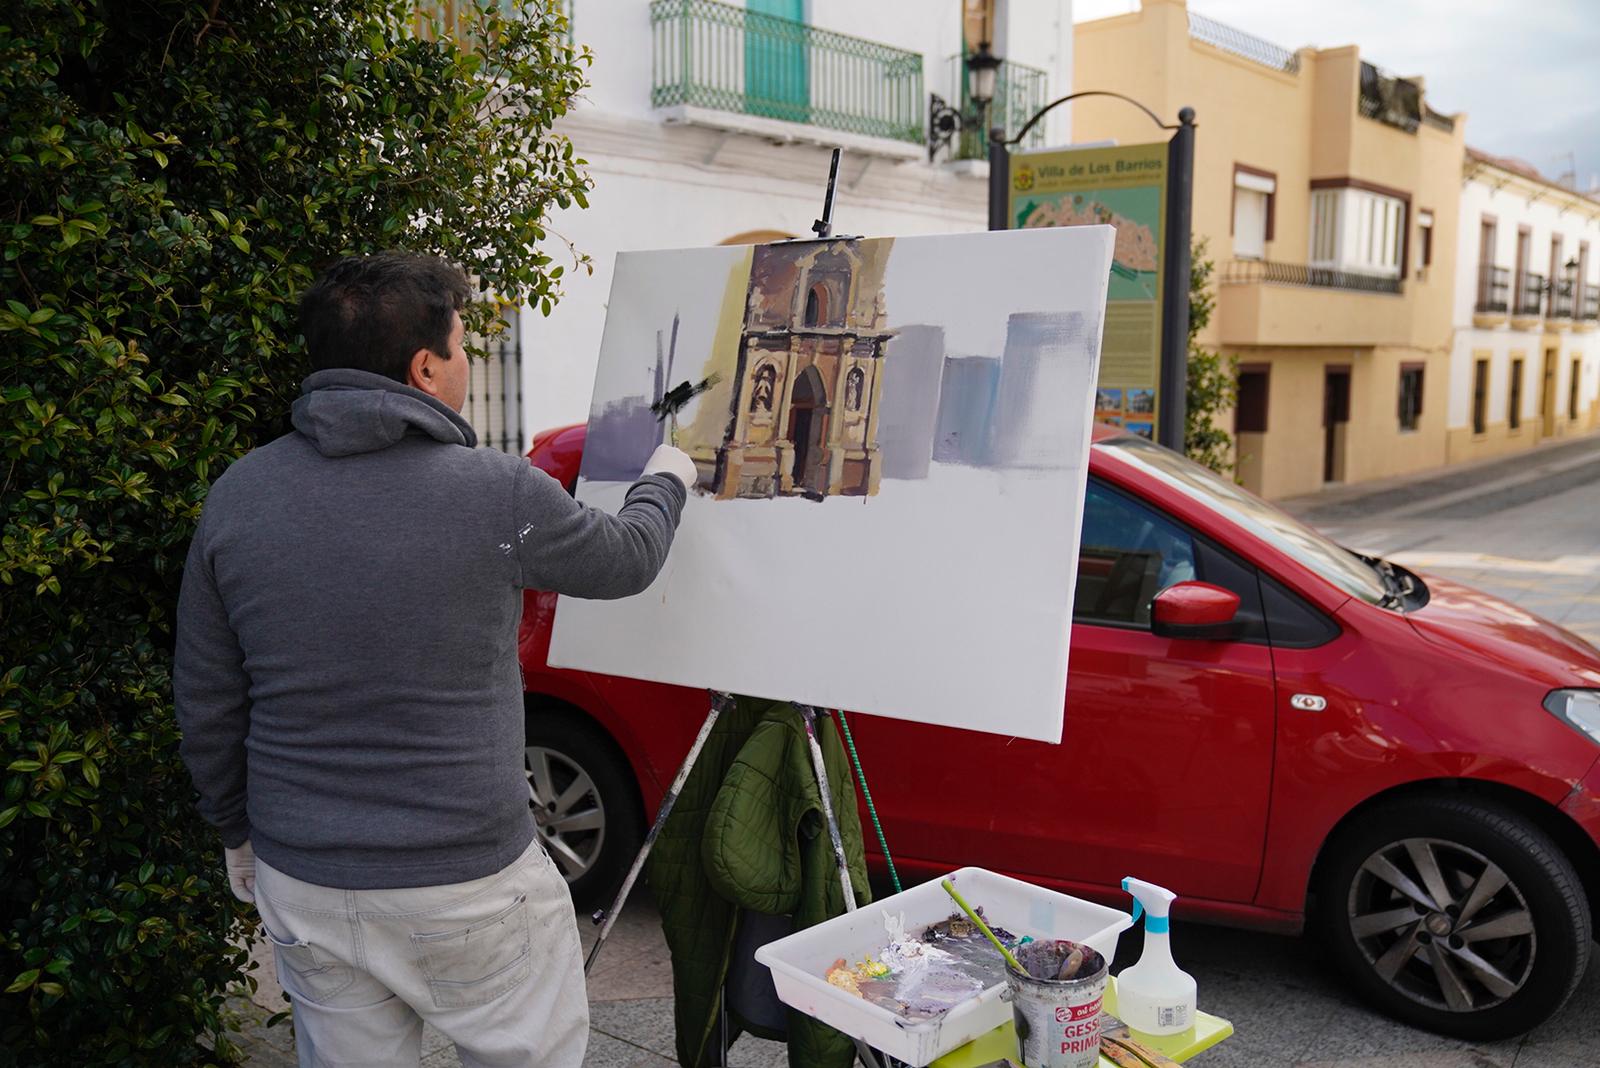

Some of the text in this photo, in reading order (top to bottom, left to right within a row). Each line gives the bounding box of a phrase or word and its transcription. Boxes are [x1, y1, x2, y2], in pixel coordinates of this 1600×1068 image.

[1038, 158, 1162, 178] Villa de Los Barrios
[1065, 1018, 1100, 1038] GESS
[1060, 1032, 1101, 1054] PRIME
